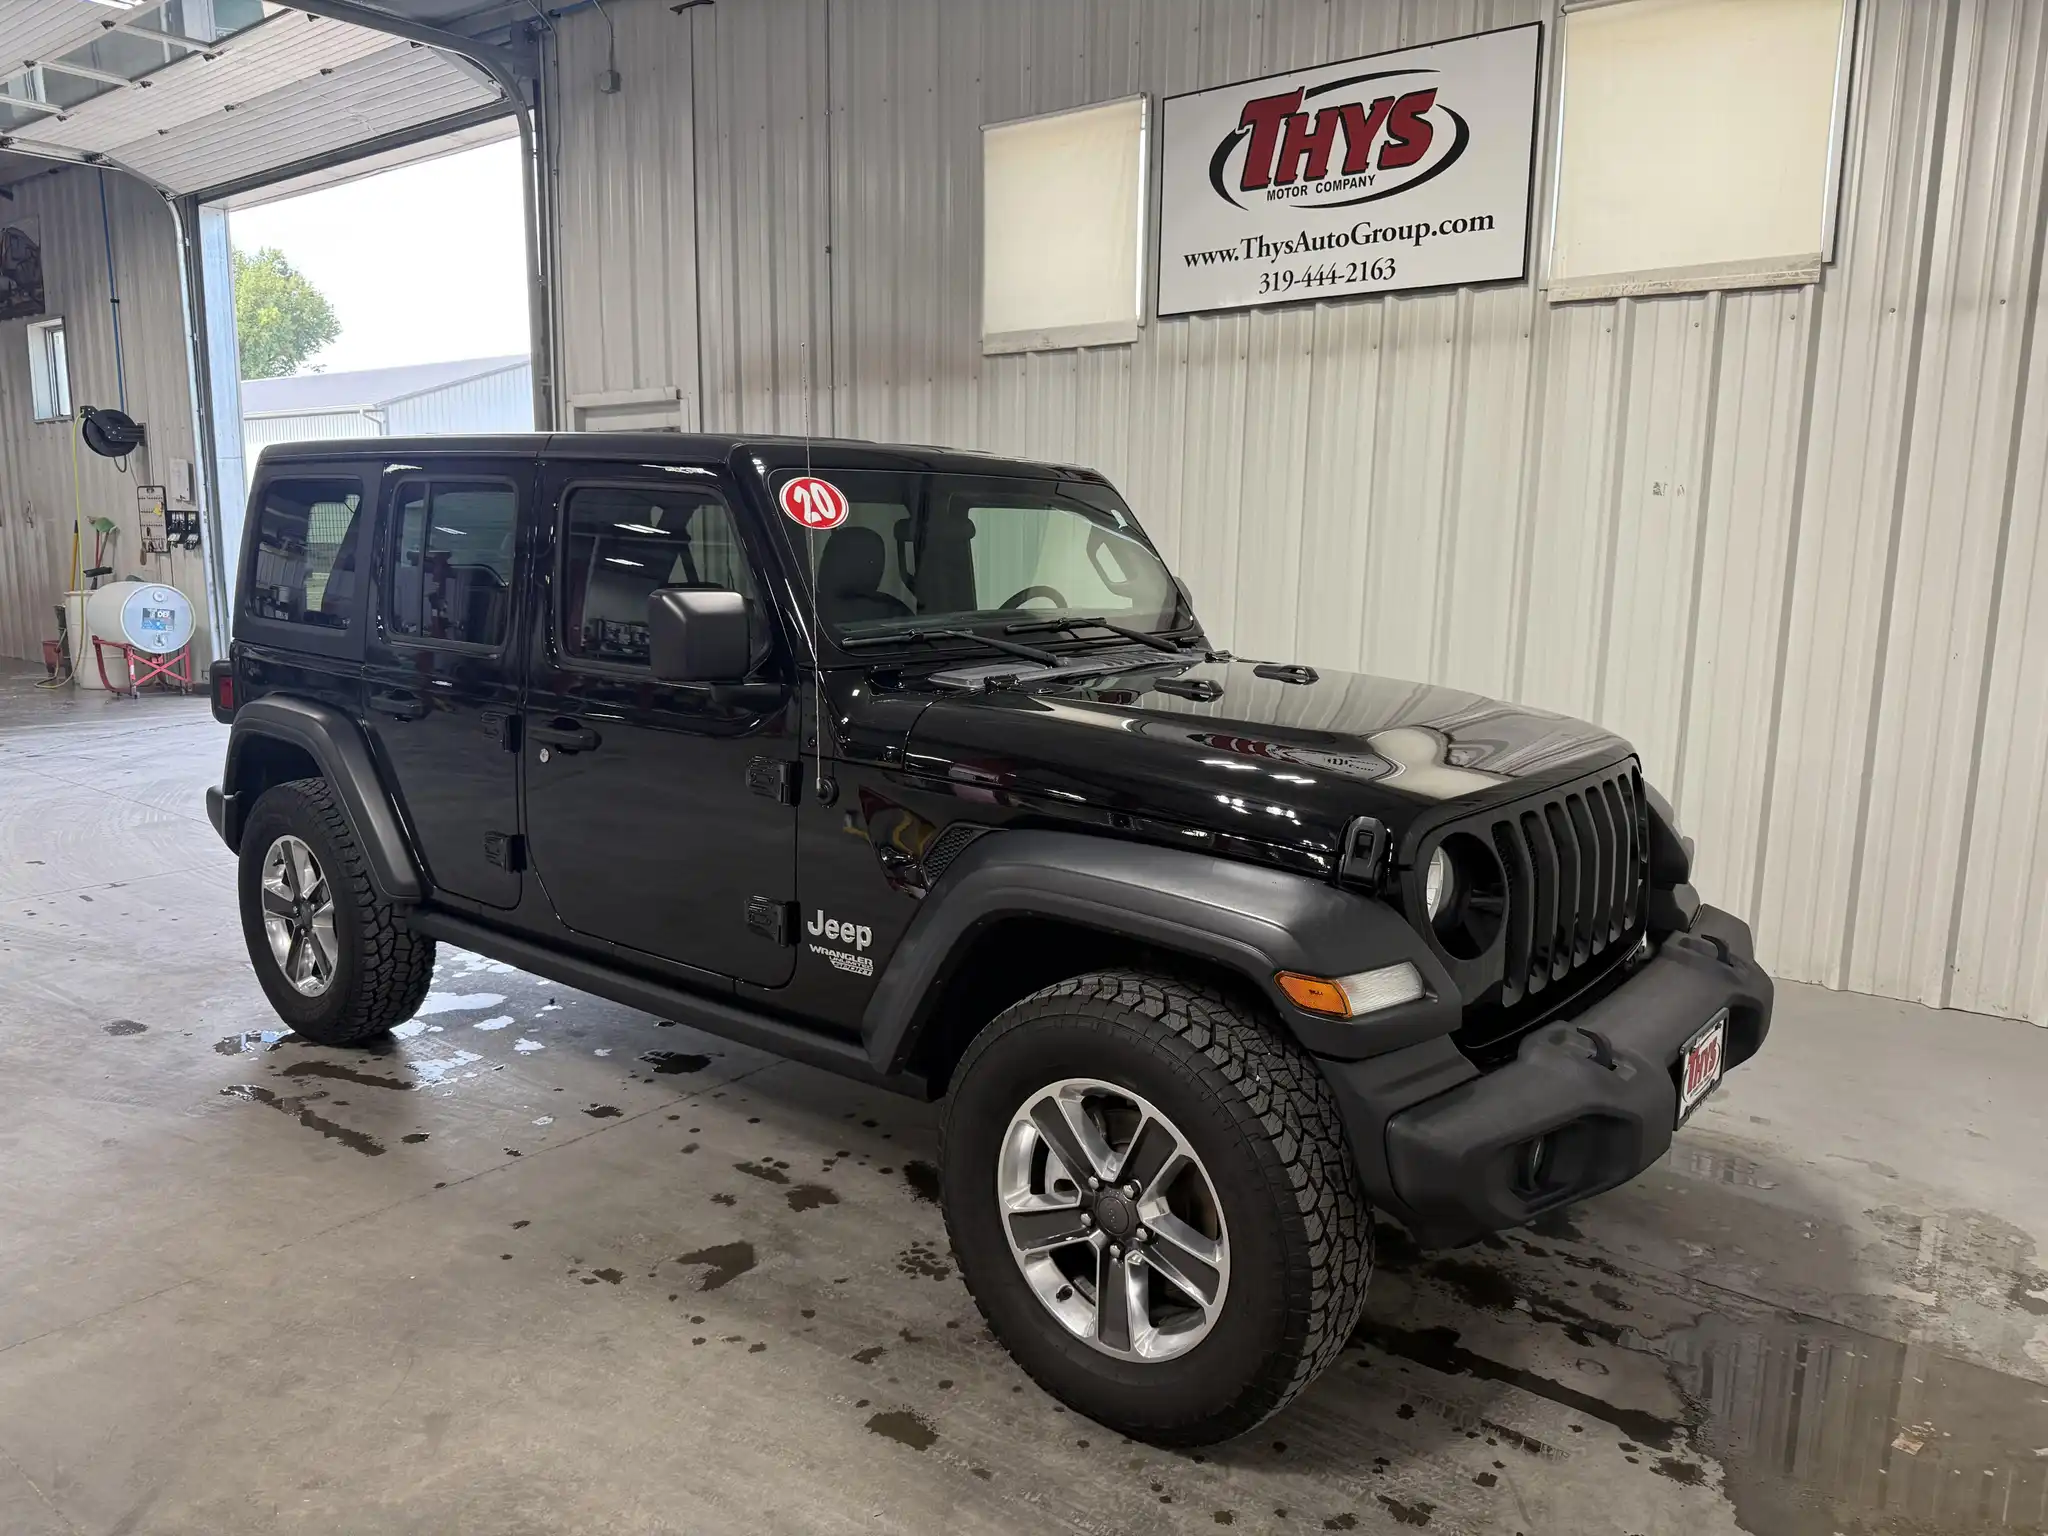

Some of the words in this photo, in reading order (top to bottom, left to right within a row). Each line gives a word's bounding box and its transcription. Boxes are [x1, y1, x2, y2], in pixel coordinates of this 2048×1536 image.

[1235, 86, 1438, 192] THYS
[1266, 184, 1308, 202] MOTOR
[1315, 174, 1376, 195] COMPANY
[1184, 213, 1495, 267] www.ThysAutoGroup.com
[1258, 257, 1396, 294] 319-444-2163
[793, 482, 836, 524] 20
[807, 909, 872, 951] Jeep
[808, 943, 873, 967] WRANGLER
[1687, 1036, 1718, 1095] THYS
